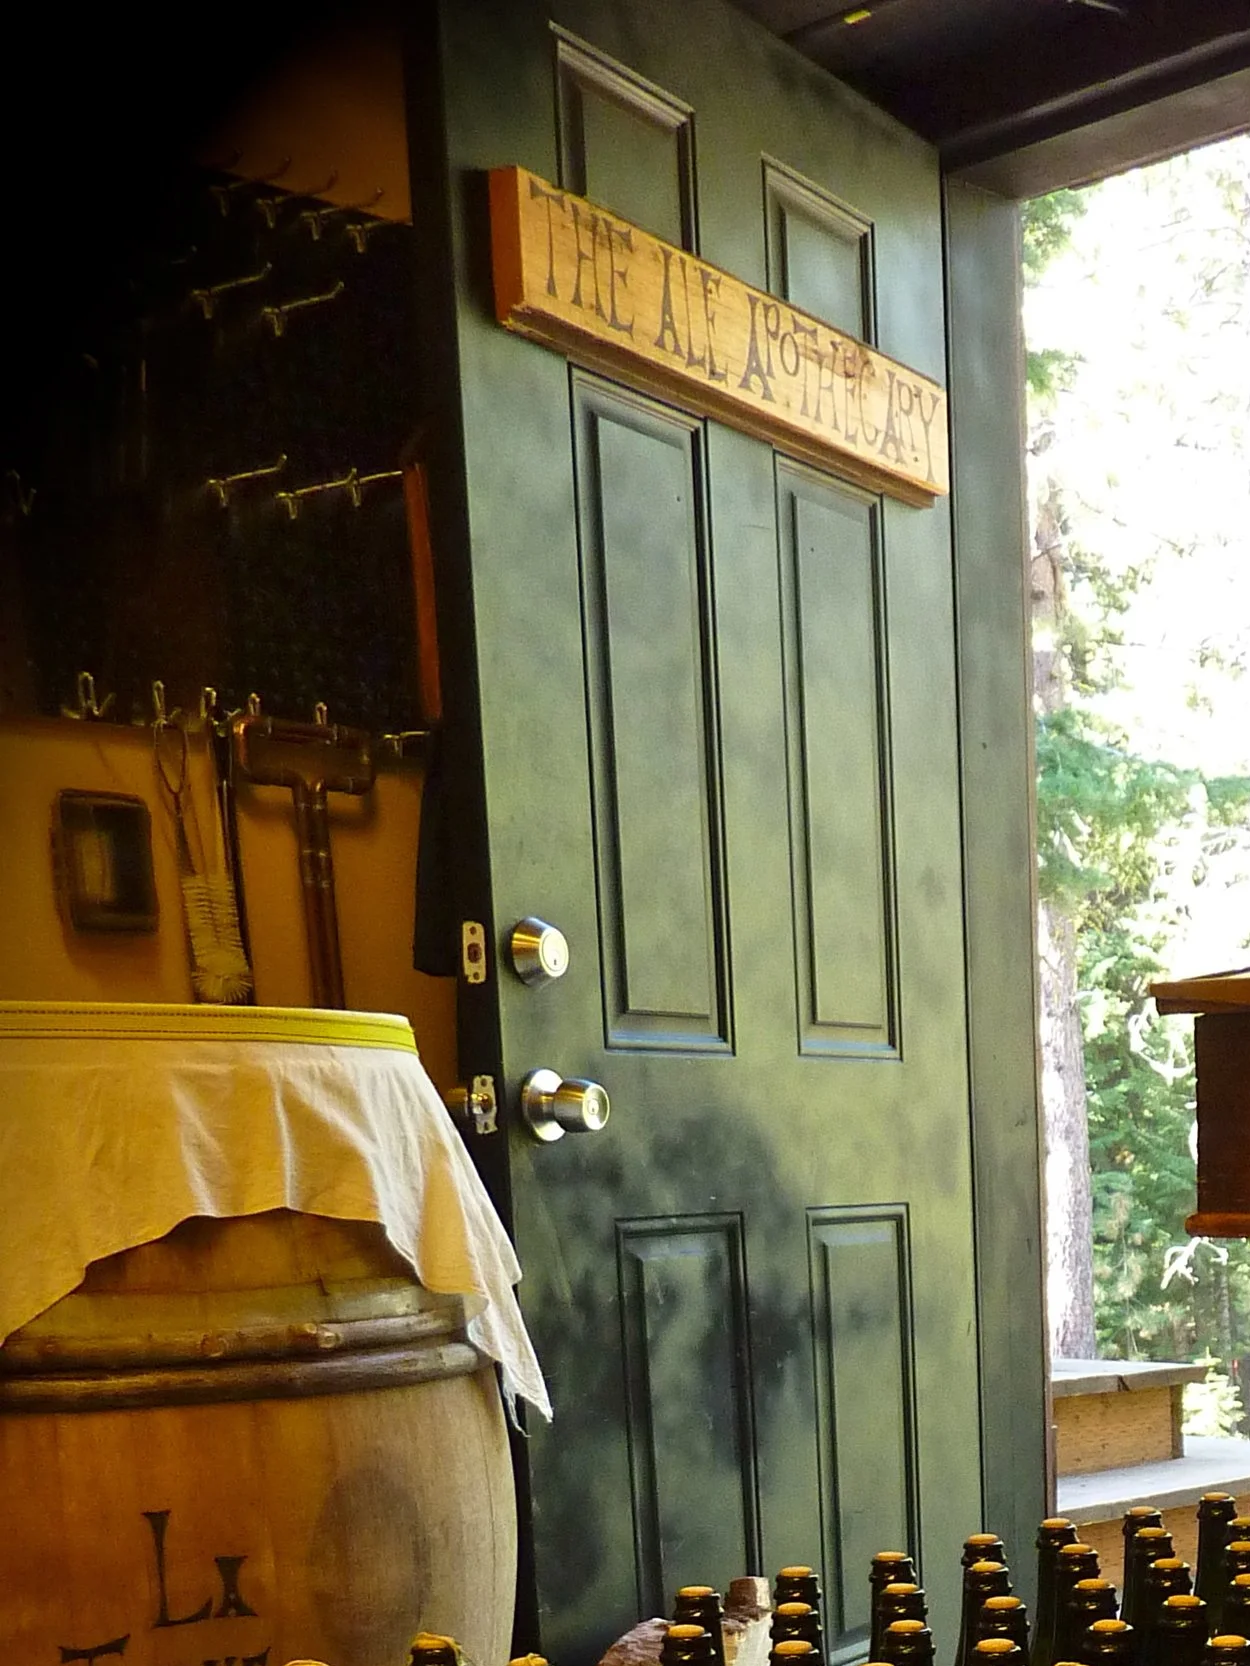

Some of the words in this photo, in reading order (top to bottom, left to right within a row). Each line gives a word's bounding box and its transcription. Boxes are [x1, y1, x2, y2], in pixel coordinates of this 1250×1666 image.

[529, 176, 635, 340] THE
[653, 246, 729, 385] ALE
[738, 291, 943, 484] APOTHECARY
